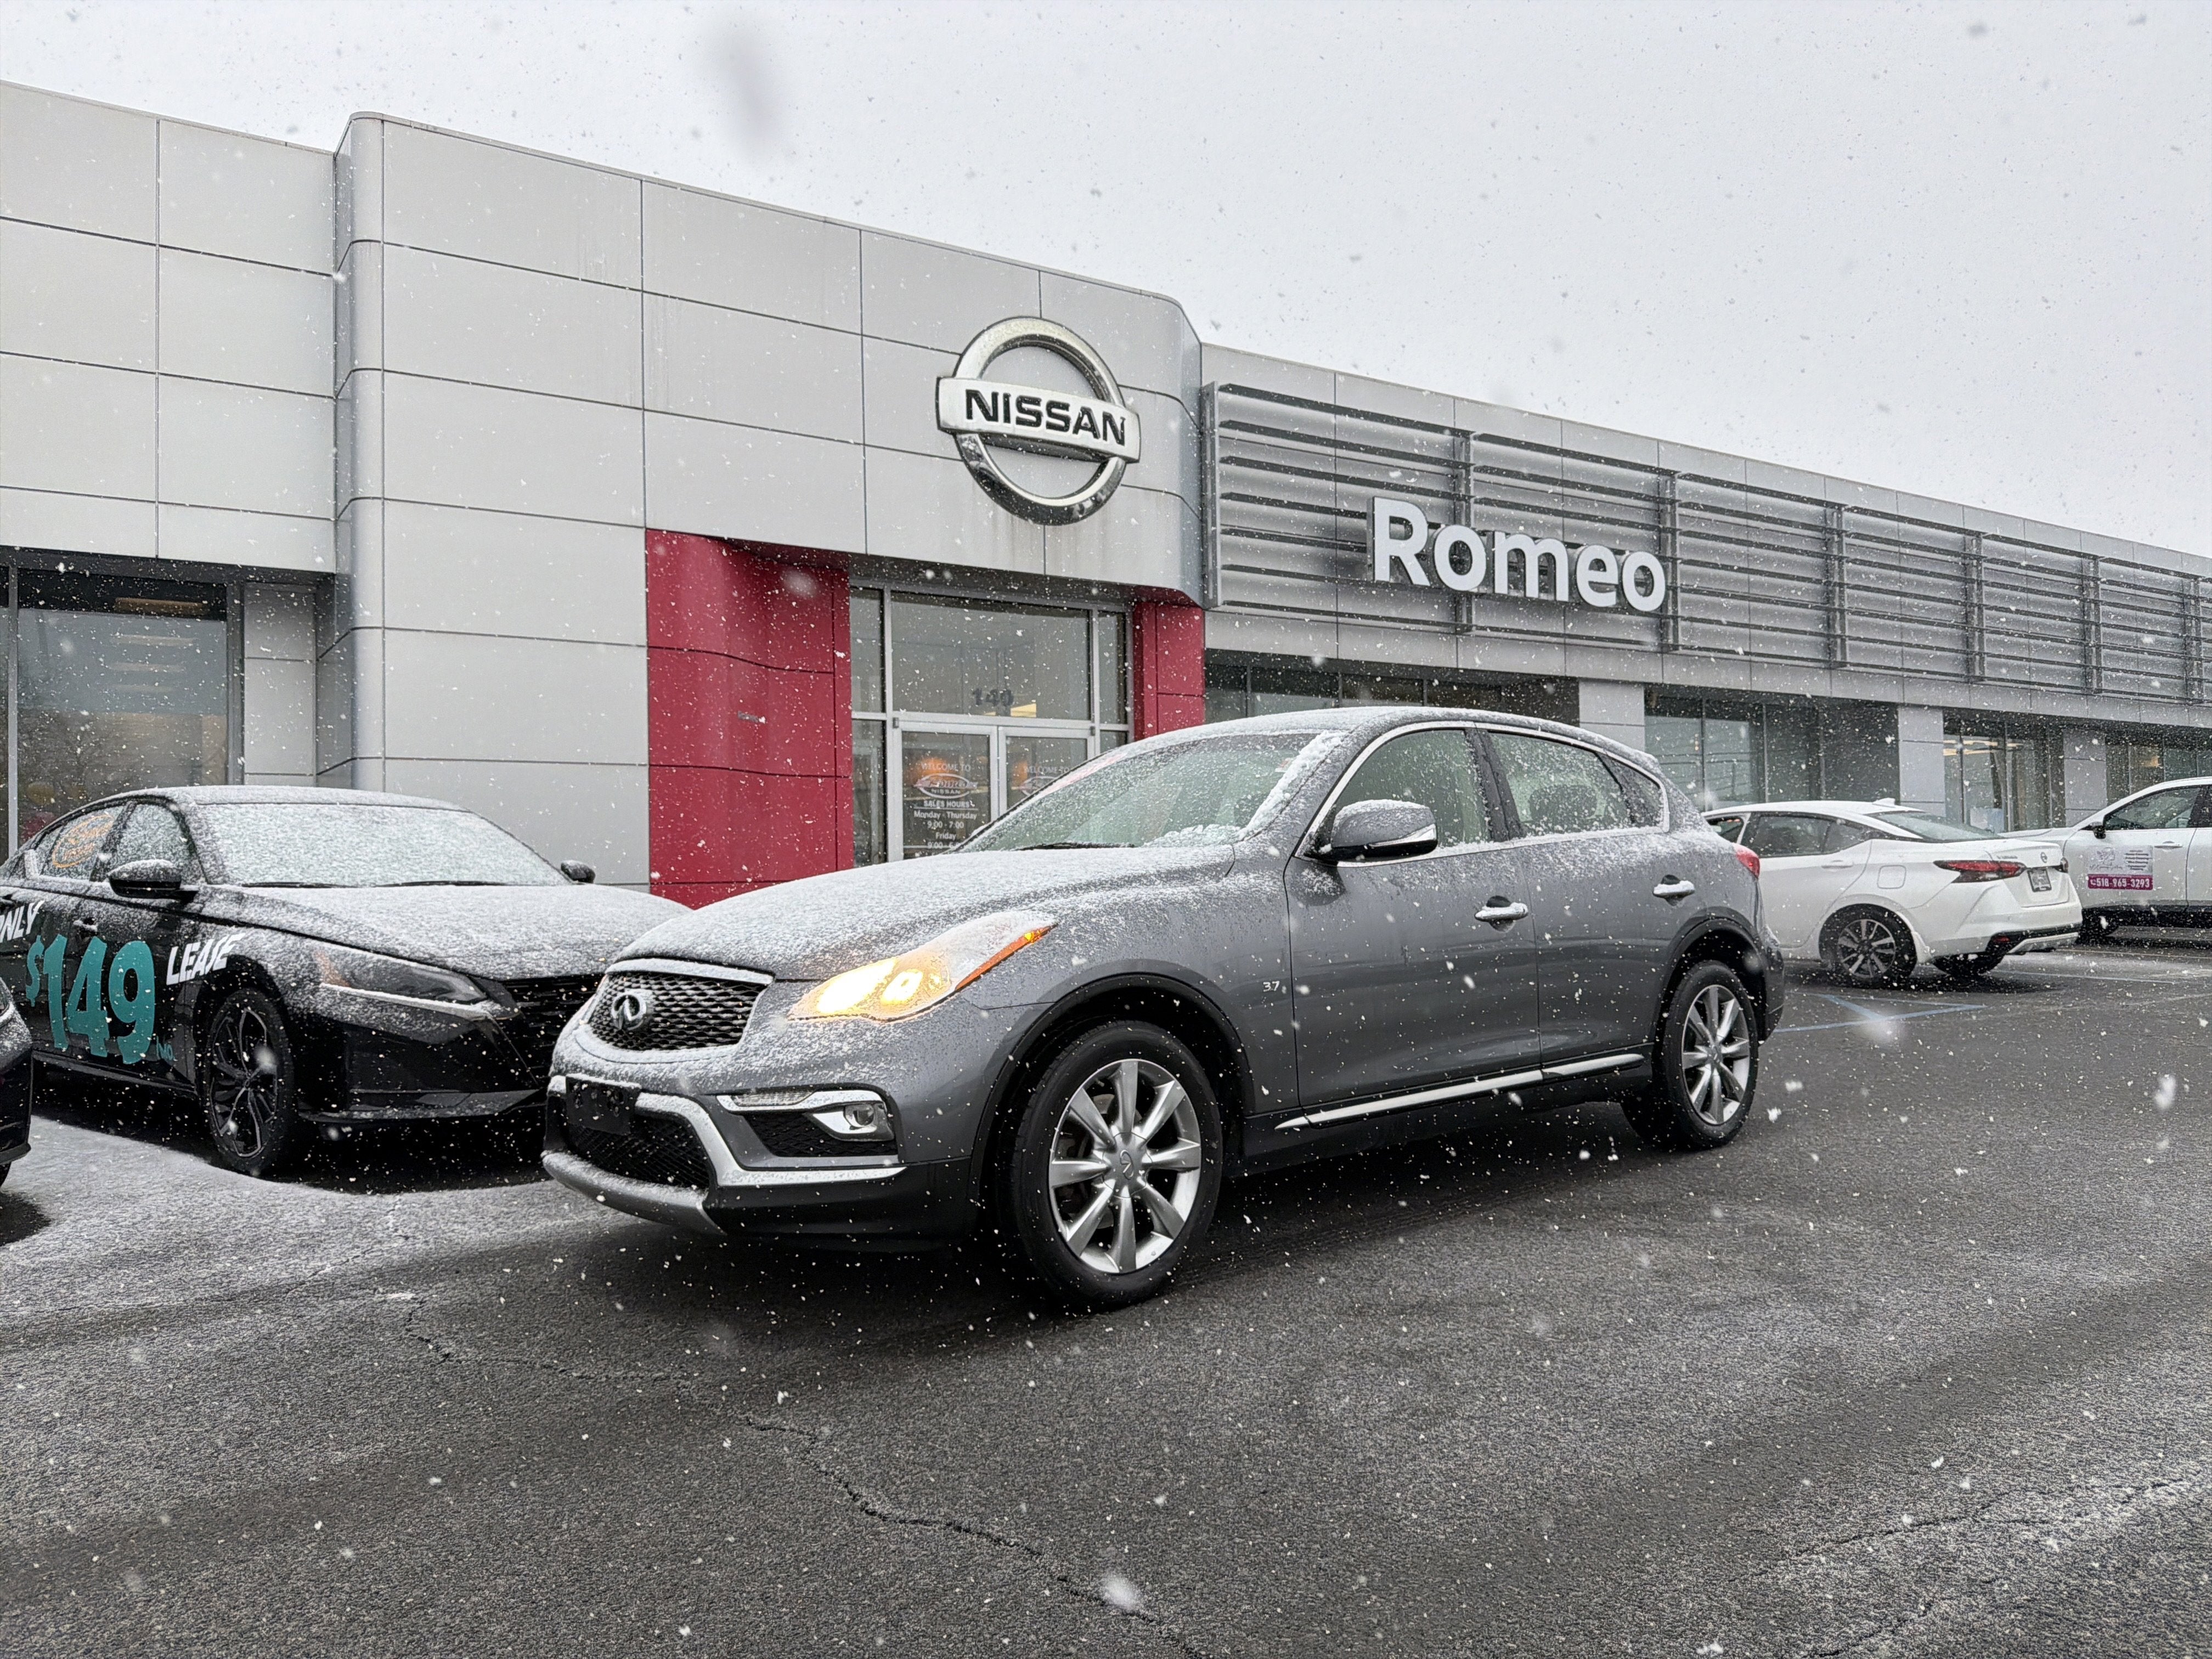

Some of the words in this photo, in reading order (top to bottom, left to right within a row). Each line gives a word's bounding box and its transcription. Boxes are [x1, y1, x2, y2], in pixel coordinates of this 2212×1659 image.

[965, 388, 1126, 447] NISSAN
[1373, 496, 1666, 612] Romeo
[973, 688, 1014, 707] 140
[921, 763, 959, 772] WELCOME
[914, 810, 941, 819] Monday
[946, 811, 977, 820] Thursday
[935, 832, 957, 840] Friday
[166, 932, 246, 985] LEASE
[26, 934, 156, 1065] $149
